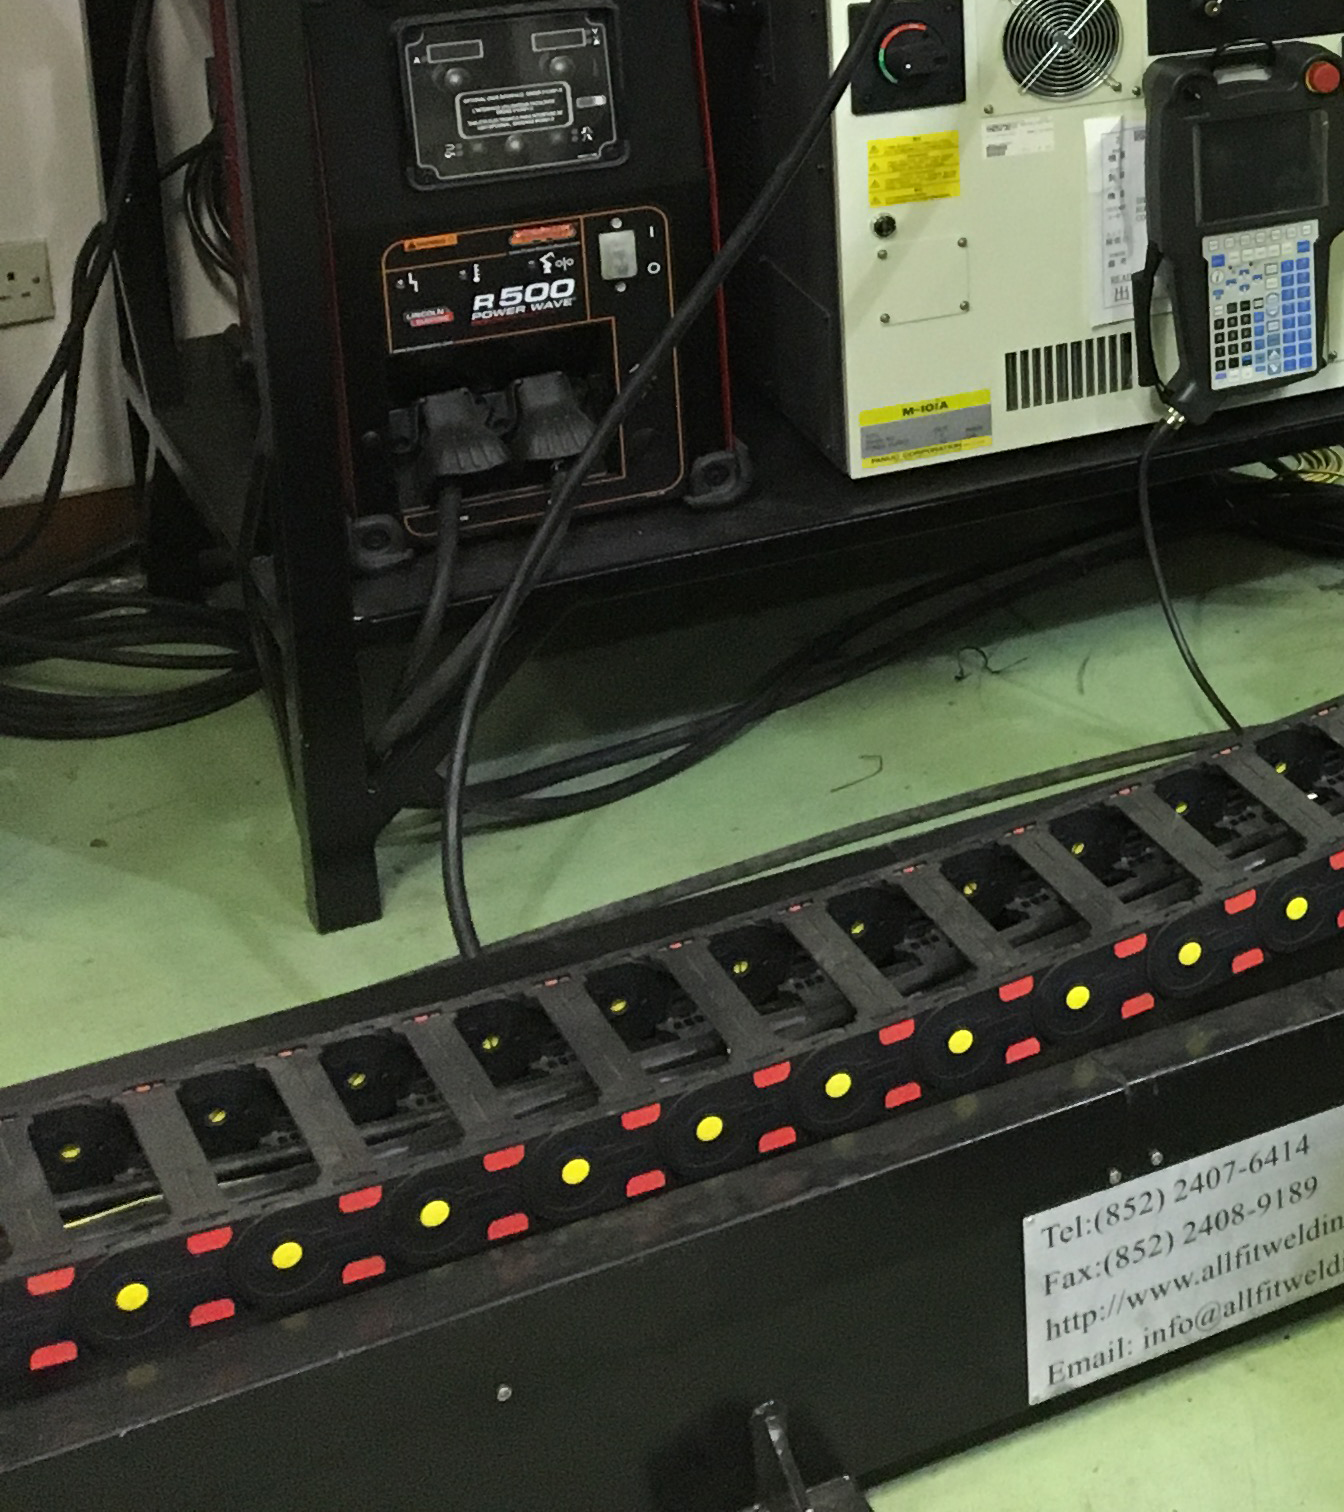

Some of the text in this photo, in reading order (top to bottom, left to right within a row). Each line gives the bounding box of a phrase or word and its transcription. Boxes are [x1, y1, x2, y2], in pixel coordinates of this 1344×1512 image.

[471, 298, 573, 321] POWER WAVE
[1041, 1134, 1311, 1249] Tel:(852) 2407-6414
[1044, 1175, 1319, 1296] Fax:(852) 2408-9189
[1047, 1338, 1134, 1386] Email:
